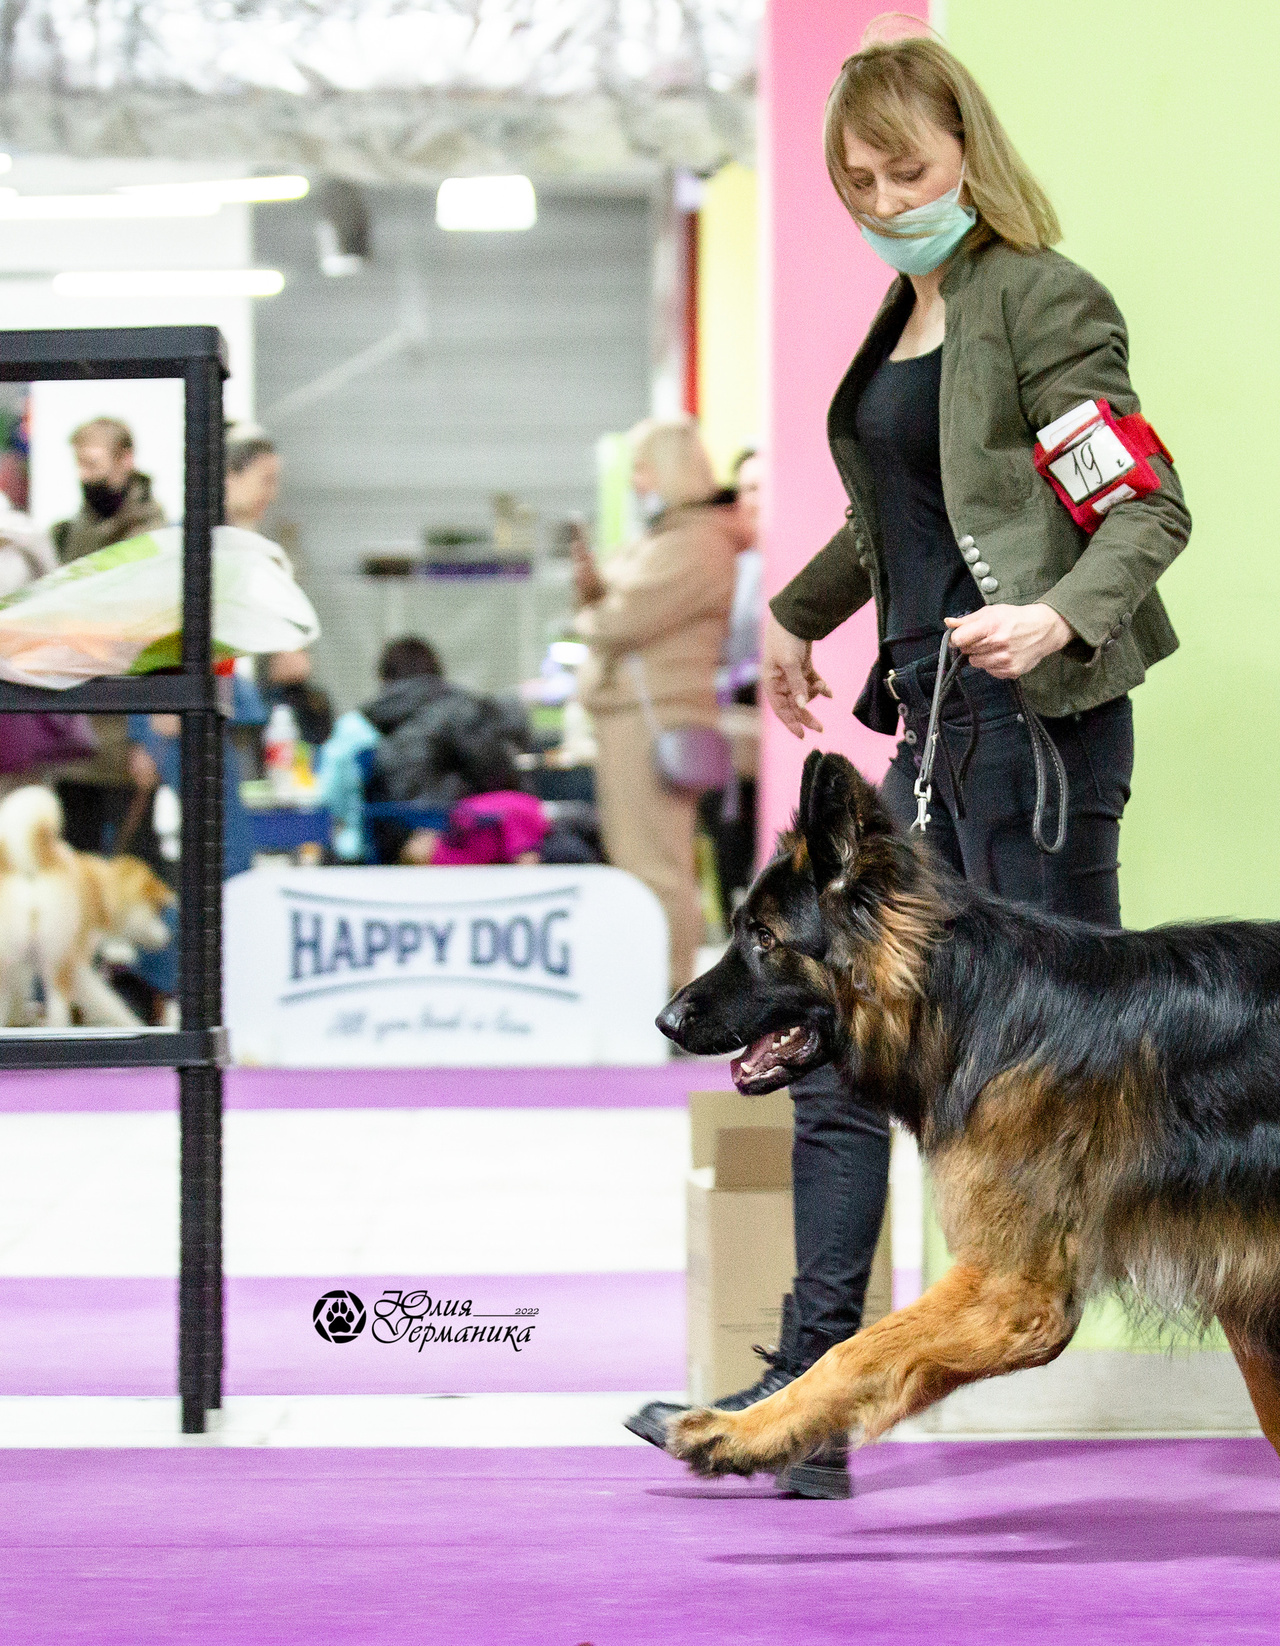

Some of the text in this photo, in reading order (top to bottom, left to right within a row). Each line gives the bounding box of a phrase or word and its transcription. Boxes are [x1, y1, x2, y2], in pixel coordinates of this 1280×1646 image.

[1071, 441, 1103, 493] 19
[289, 908, 570, 981] HAPPY DOG
